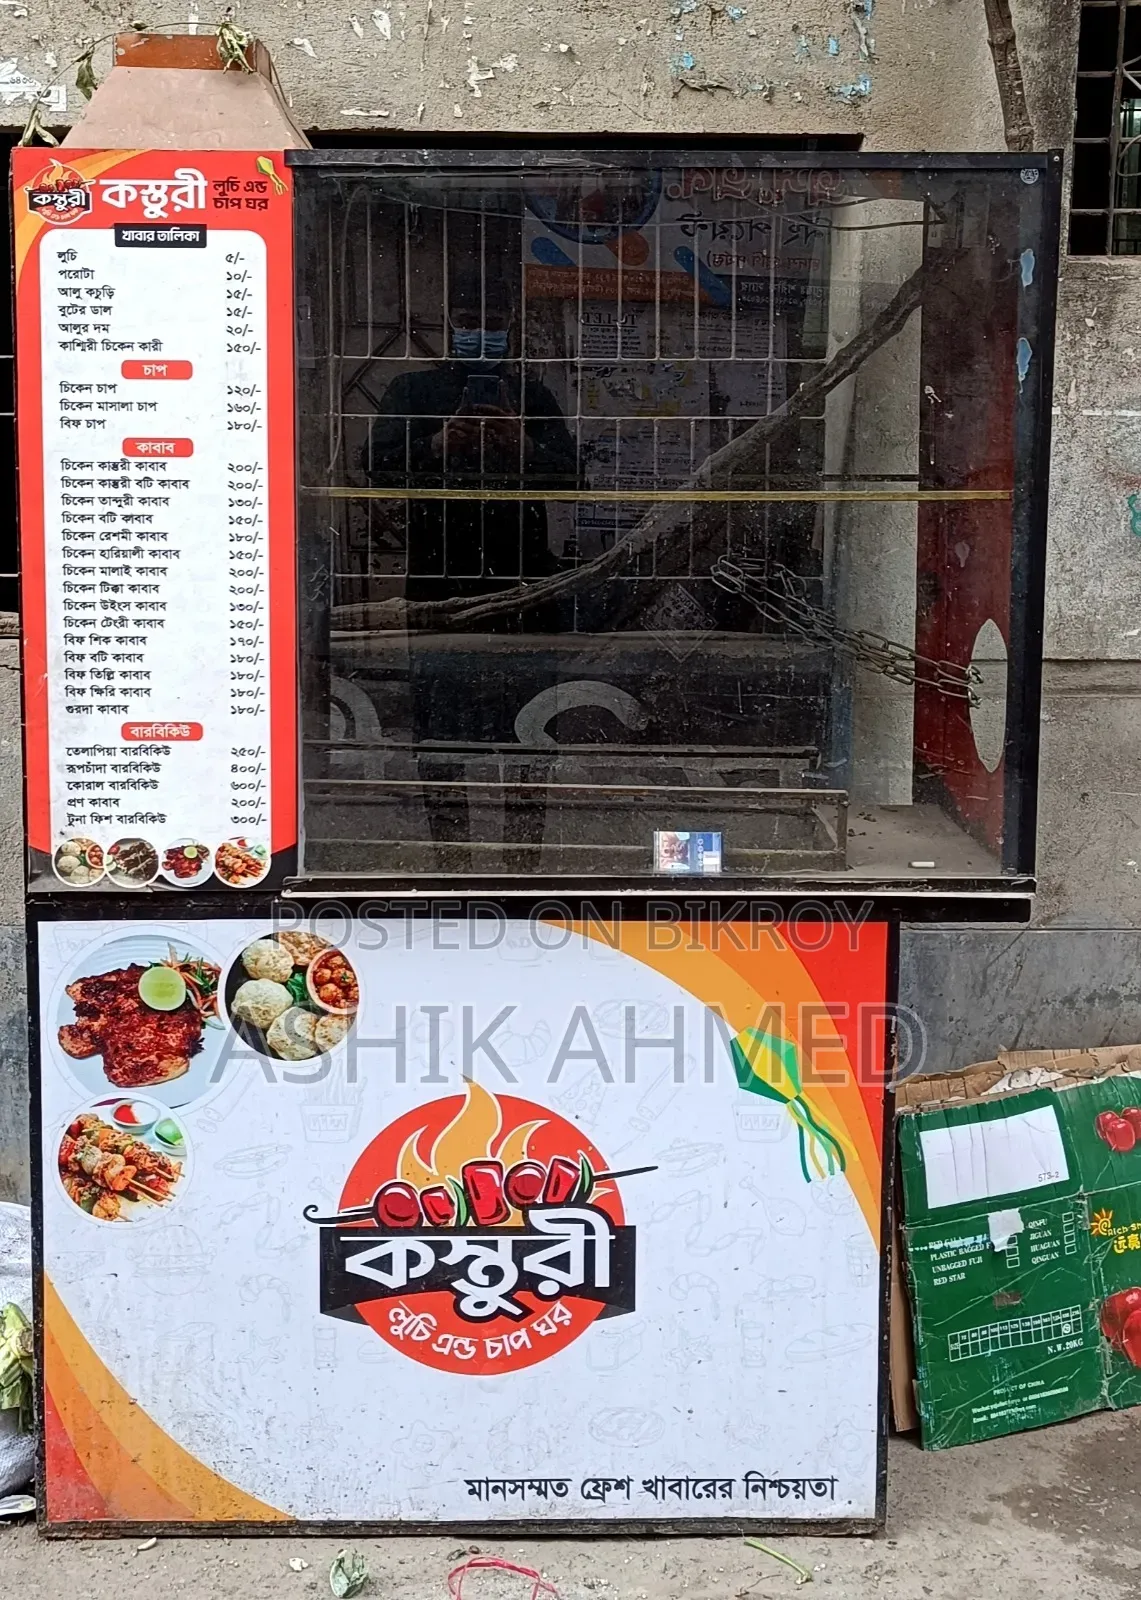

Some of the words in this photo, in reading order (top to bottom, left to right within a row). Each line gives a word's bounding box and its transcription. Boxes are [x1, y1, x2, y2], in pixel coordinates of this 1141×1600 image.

[213, 176, 241, 196] লুচি
[243, 180, 269, 193] এন্ড
[99, 168, 208, 219] কস্তুরী
[213, 197, 241, 210] চাপ
[245, 197, 269, 211] ঘর
[122, 229, 155, 243] খাবার
[157, 227, 200, 242] তালিকা
[56, 248, 78, 264] লুচি
[58, 266, 95, 280] পরোটা
[57, 287, 82, 300] আলু
[57, 302, 86, 318] বুটের
[90, 305, 113, 316] ডাল
[57, 323, 90, 336] আলুর
[92, 323, 111, 334] দম
[101, 338, 135, 352] চিকেন
[137, 338, 164, 352] কারী
[142, 363, 168, 377] চাপ
[58, 380, 93, 394] চিকেন
[96, 383, 118, 394] চাপ
[58, 398, 94, 411] চিকেন
[96, 401, 134, 412] মাসালা
[136, 401, 158, 412] চাপ
[59, 415, 82, 429] বিফ
[85, 418, 107, 430] চাপ
[135, 441, 176, 455] কাবাব
[60, 457, 94, 471] চিকেন
[134, 460, 167, 472] কাবাব
[60, 475, 95, 489] চিকেন
[134, 476, 154, 489] বটি
[156, 479, 191, 489] কাবাব
[60, 492, 95, 506] চিকেন
[137, 496, 171, 507] কাবাব
[61, 510, 96, 524] চিকেন
[98, 511, 118, 524] বটি
[120, 513, 154, 524] কাবাব
[61, 528, 96, 541] চিকেন
[135, 531, 169, 542] কাবাব
[61, 545, 96, 559] চিকেন
[147, 549, 181, 560] কাবাব
[61, 563, 96, 576] চিকেন
[99, 563, 132, 577] মালাই
[134, 566, 168, 577] কাবাব
[62, 580, 97, 594] চিকেন
[127, 583, 161, 594] কাবাব
[62, 597, 97, 611] চিকেন
[134, 601, 167, 612] কাবাব
[62, 615, 97, 628] চিকেন
[132, 618, 166, 629] কাবাব
[63, 632, 86, 646] বিফ
[89, 632, 112, 646] শিক
[114, 635, 148, 646] কাবাব
[63, 649, 86, 663] বিফ
[89, 650, 109, 663] বটি
[111, 652, 145, 663] কাবাব
[63, 667, 87, 680] বিফ
[118, 670, 151, 680] কাবাব
[64, 684, 87, 698] বিফ
[119, 687, 152, 698] কাবাব
[96, 704, 130, 715] কাবাব
[130, 722, 191, 738] বারবিকিউ
[65, 743, 117, 757] তেলাপিয়া
[120, 743, 172, 757] বারবিকিউ
[110, 761, 162, 774] বারবিকিউ
[65, 780, 105, 791] কোরাল
[108, 777, 160, 791] বারবিকিউ
[87, 797, 121, 808] কাবাব
[90, 811, 113, 825] ফিশ
[115, 811, 167, 825] বারবিকিউ
[930, 1249, 957, 1262] PLASTIC
[958, 1243, 985, 1255] BAGGED
[340, 1207, 616, 1318] কস্তুরী
[932, 1260, 968, 1274] UNBAGGED
[968, 1256, 983, 1266] FUJI
[933, 1276, 948, 1286] RED
[949, 1272, 966, 1283] STAR
[388, 1300, 437, 1341] লুচি
[432, 1332, 479, 1359] এন্ড
[483, 1329, 533, 1358] চাপ
[533, 1301, 574, 1337] ঘর
[463, 1476, 573, 1501] মানসম্মত
[580, 1475, 633, 1503] ফ্রেশ
[642, 1476, 737, 1501] খাবারের
[744, 1470, 839, 1501] নিশ্চয়তা
